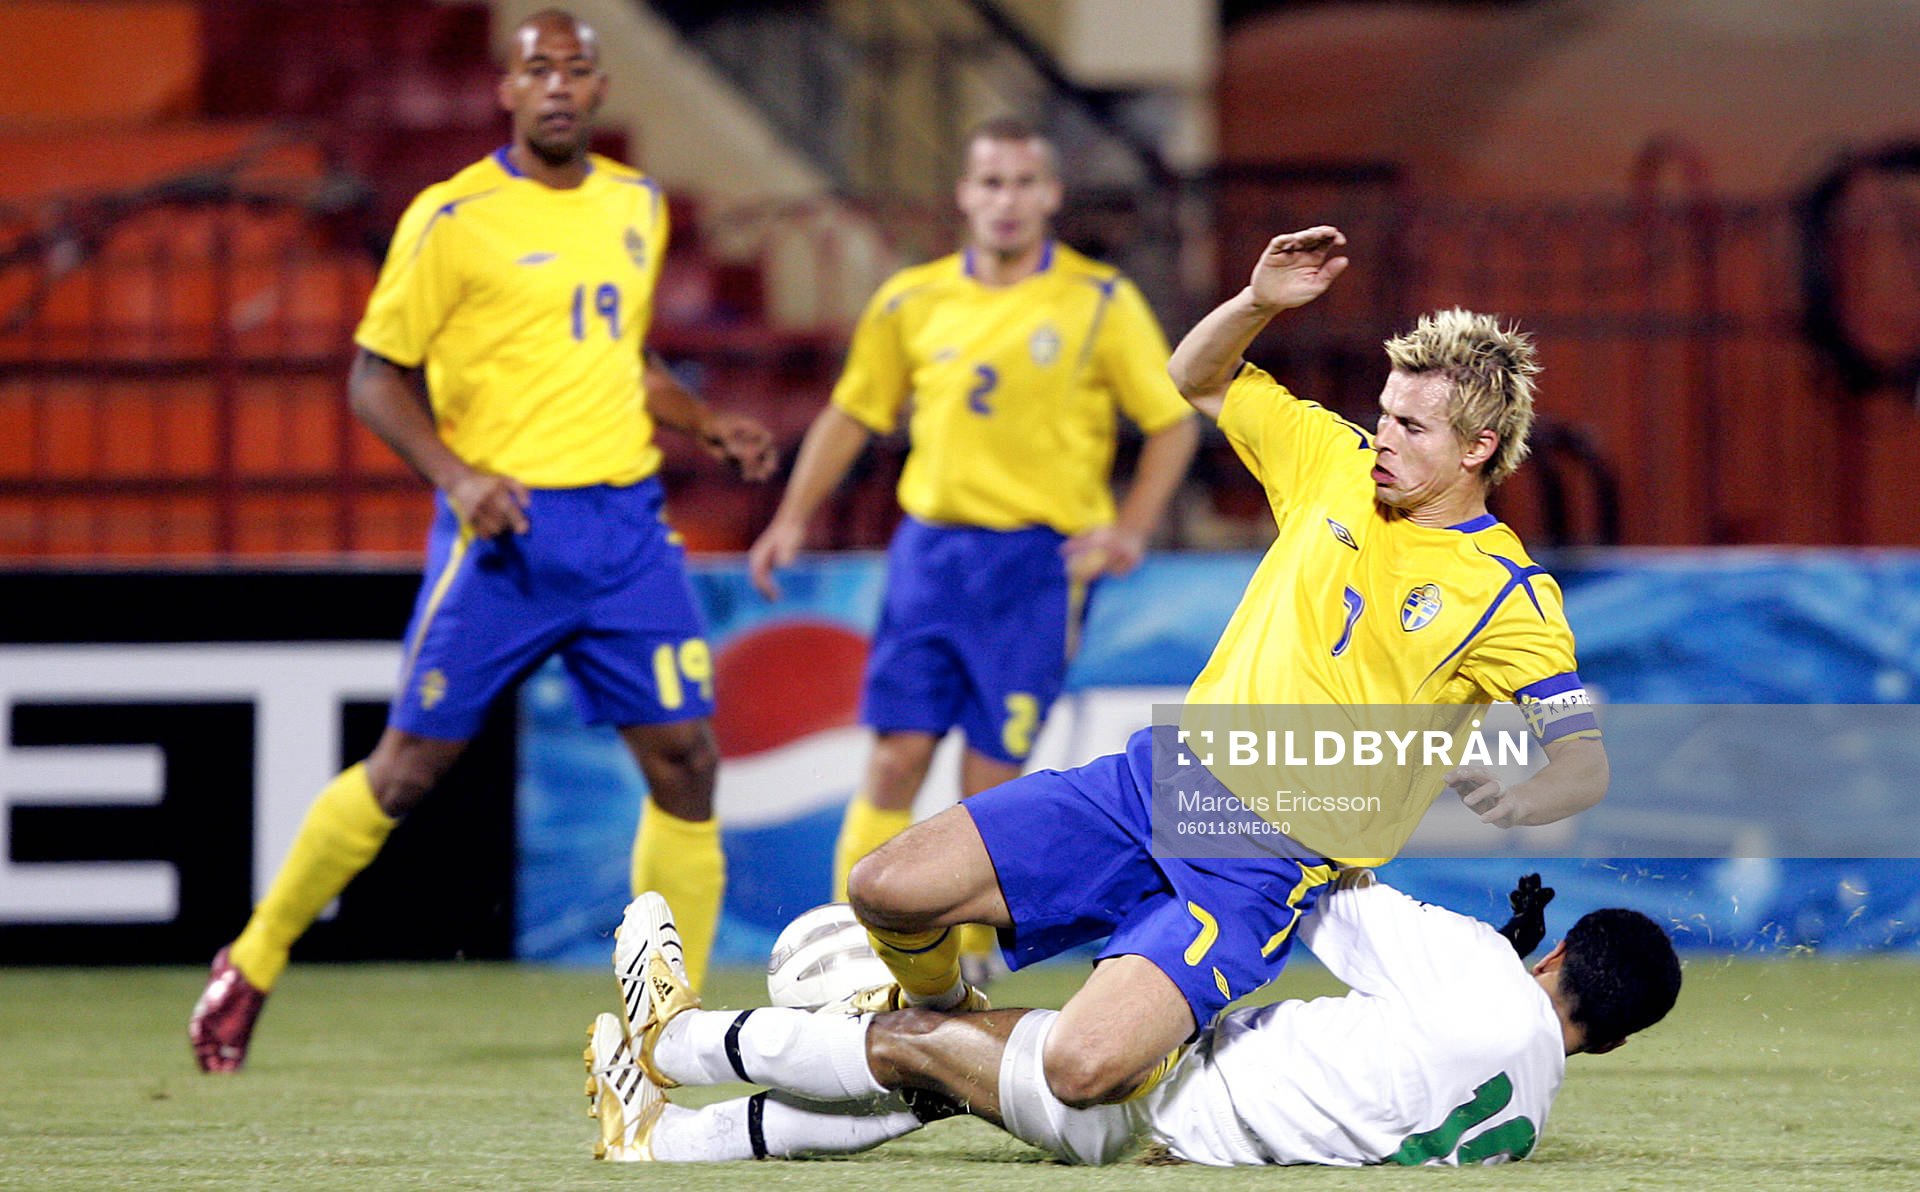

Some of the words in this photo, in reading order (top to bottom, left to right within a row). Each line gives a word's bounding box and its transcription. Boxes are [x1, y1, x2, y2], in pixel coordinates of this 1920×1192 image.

[571, 283, 621, 341] 19
[968, 365, 998, 415] 2
[1331, 585, 1366, 657] 7
[653, 638, 713, 710] 19
[1002, 692, 1038, 757] 2
[1183, 900, 1220, 967] 7
